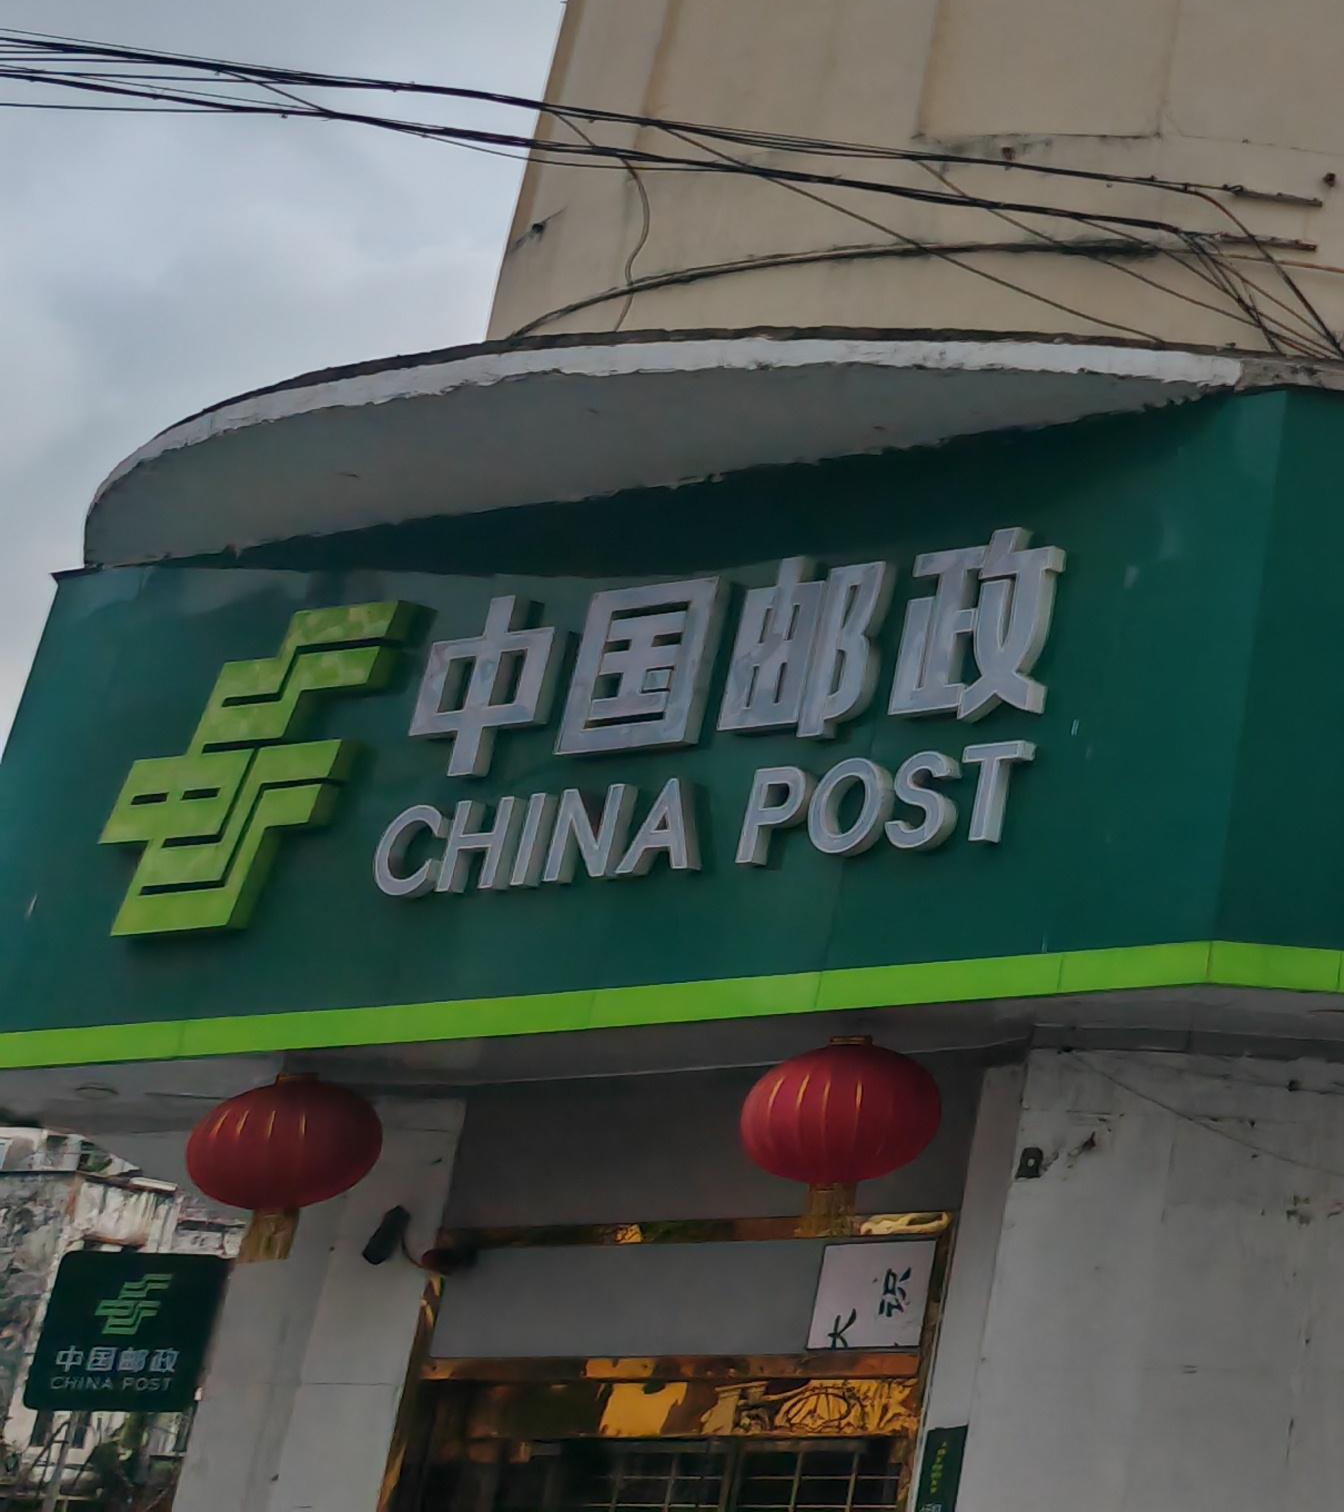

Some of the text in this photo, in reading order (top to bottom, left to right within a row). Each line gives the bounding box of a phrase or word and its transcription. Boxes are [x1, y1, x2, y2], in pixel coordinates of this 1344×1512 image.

[409, 527, 1066, 777] 中国邮政
[373, 740, 1036, 897] CHINA POST
[50, 1376, 173, 1392] CHINA POST
[55, 1345, 180, 1373] 中国邮政
